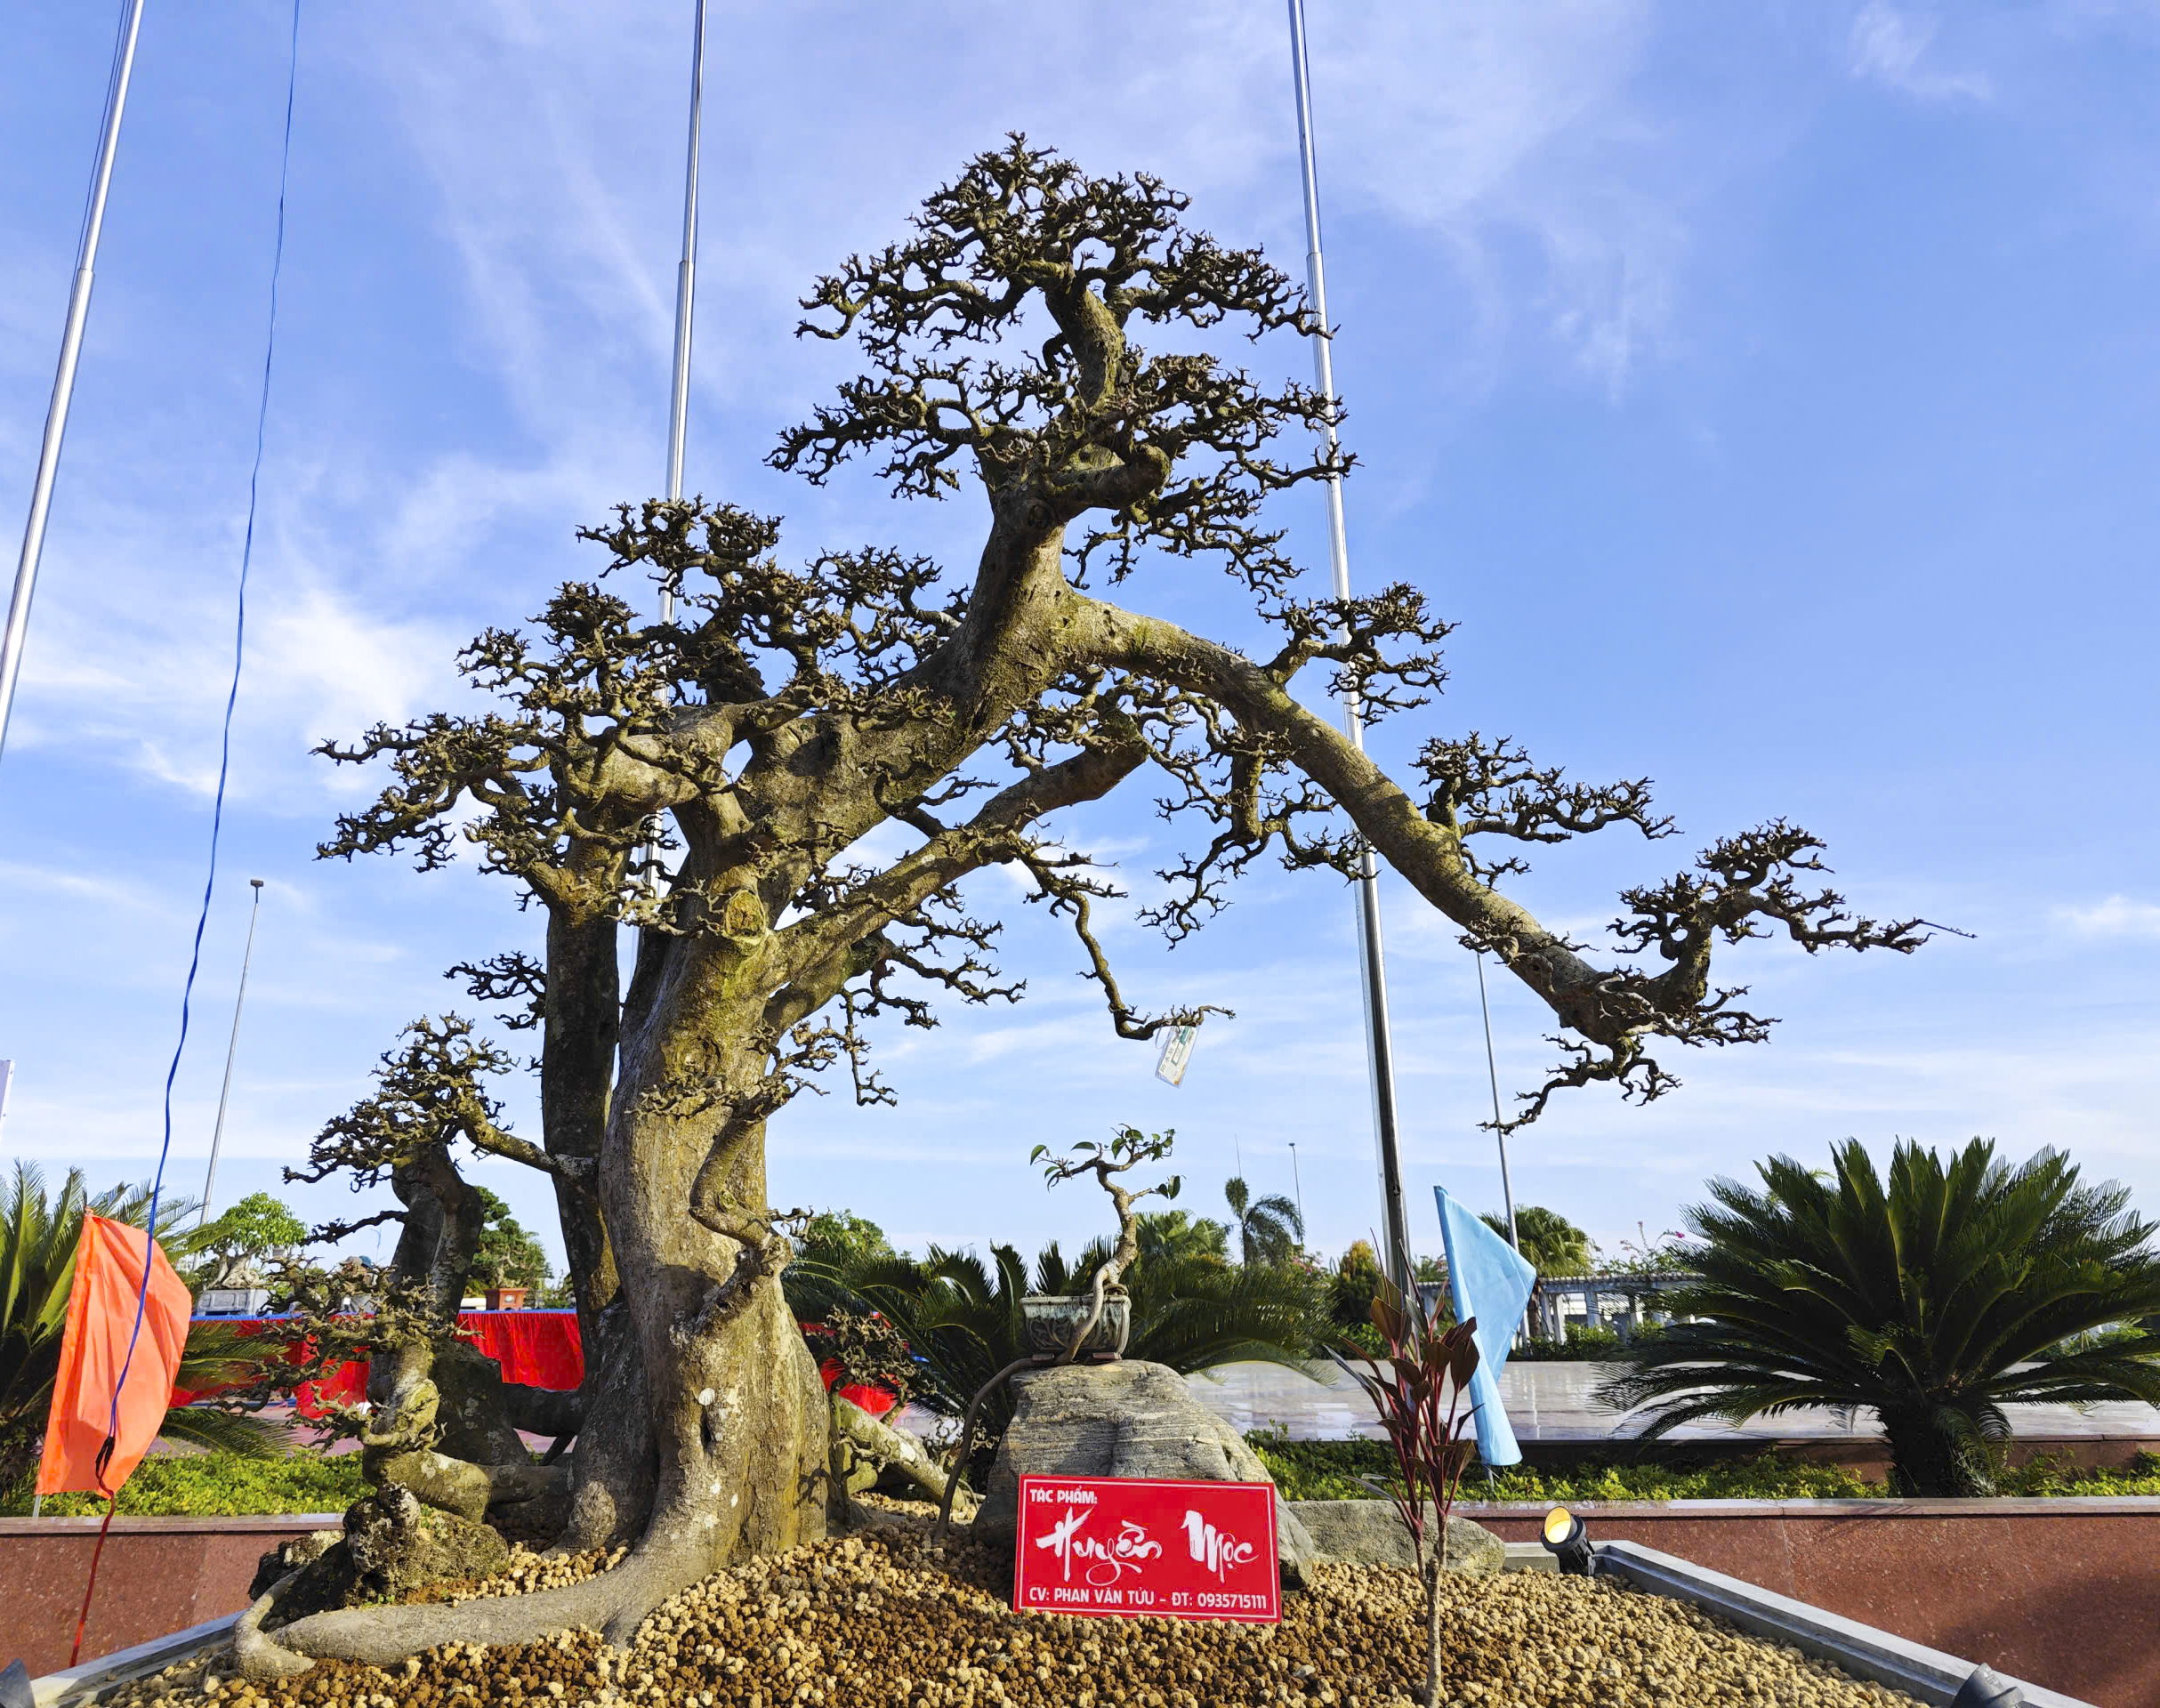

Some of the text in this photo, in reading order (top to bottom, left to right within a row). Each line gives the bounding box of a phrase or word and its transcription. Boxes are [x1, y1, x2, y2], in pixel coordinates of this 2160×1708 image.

[1029, 1485, 1098, 1504] TÁC PHẨM:
[1035, 1505, 1260, 1586] Huyền Mộc
[1029, 1587, 1050, 1601] CV:
[1054, 1588, 1090, 1603] PHAN
[1094, 1587, 1122, 1604] VĂN
[1127, 1586, 1155, 1605] TỬU
[1172, 1591, 1193, 1607] ĐT:
[1197, 1592, 1267, 1609] 0935715111
